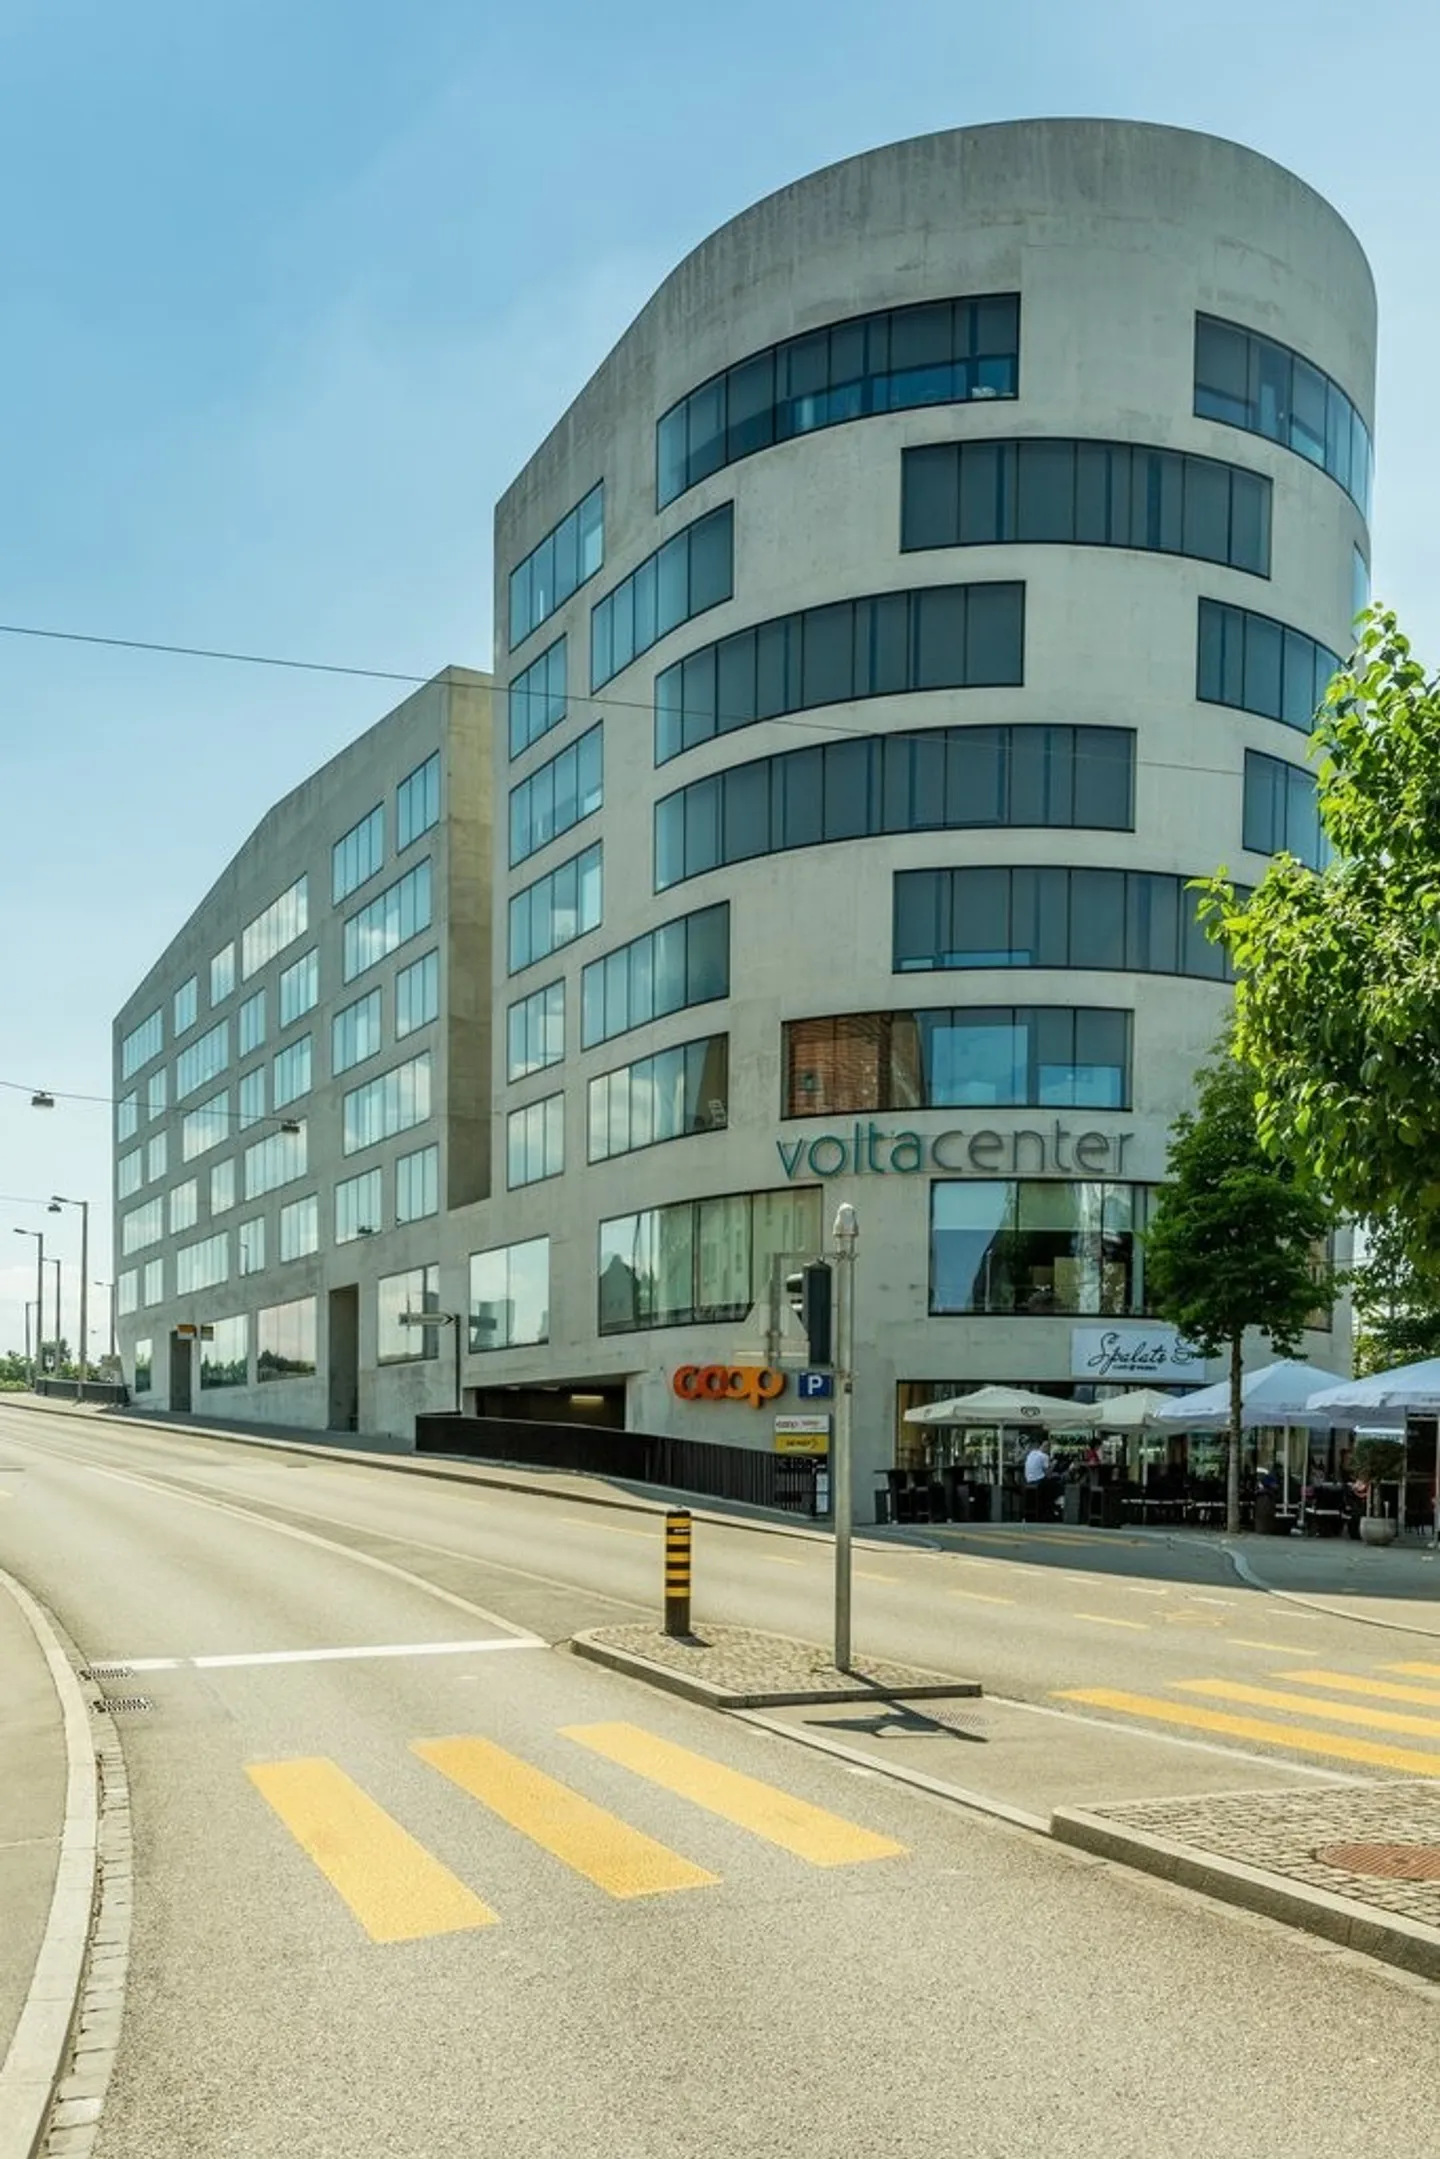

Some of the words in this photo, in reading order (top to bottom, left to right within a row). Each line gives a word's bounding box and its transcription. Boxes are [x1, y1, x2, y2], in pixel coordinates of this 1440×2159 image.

[776, 1119, 1135, 1179] voltacenter
[673, 1365, 786, 1409] coop
[807, 1375, 823, 1395] P
